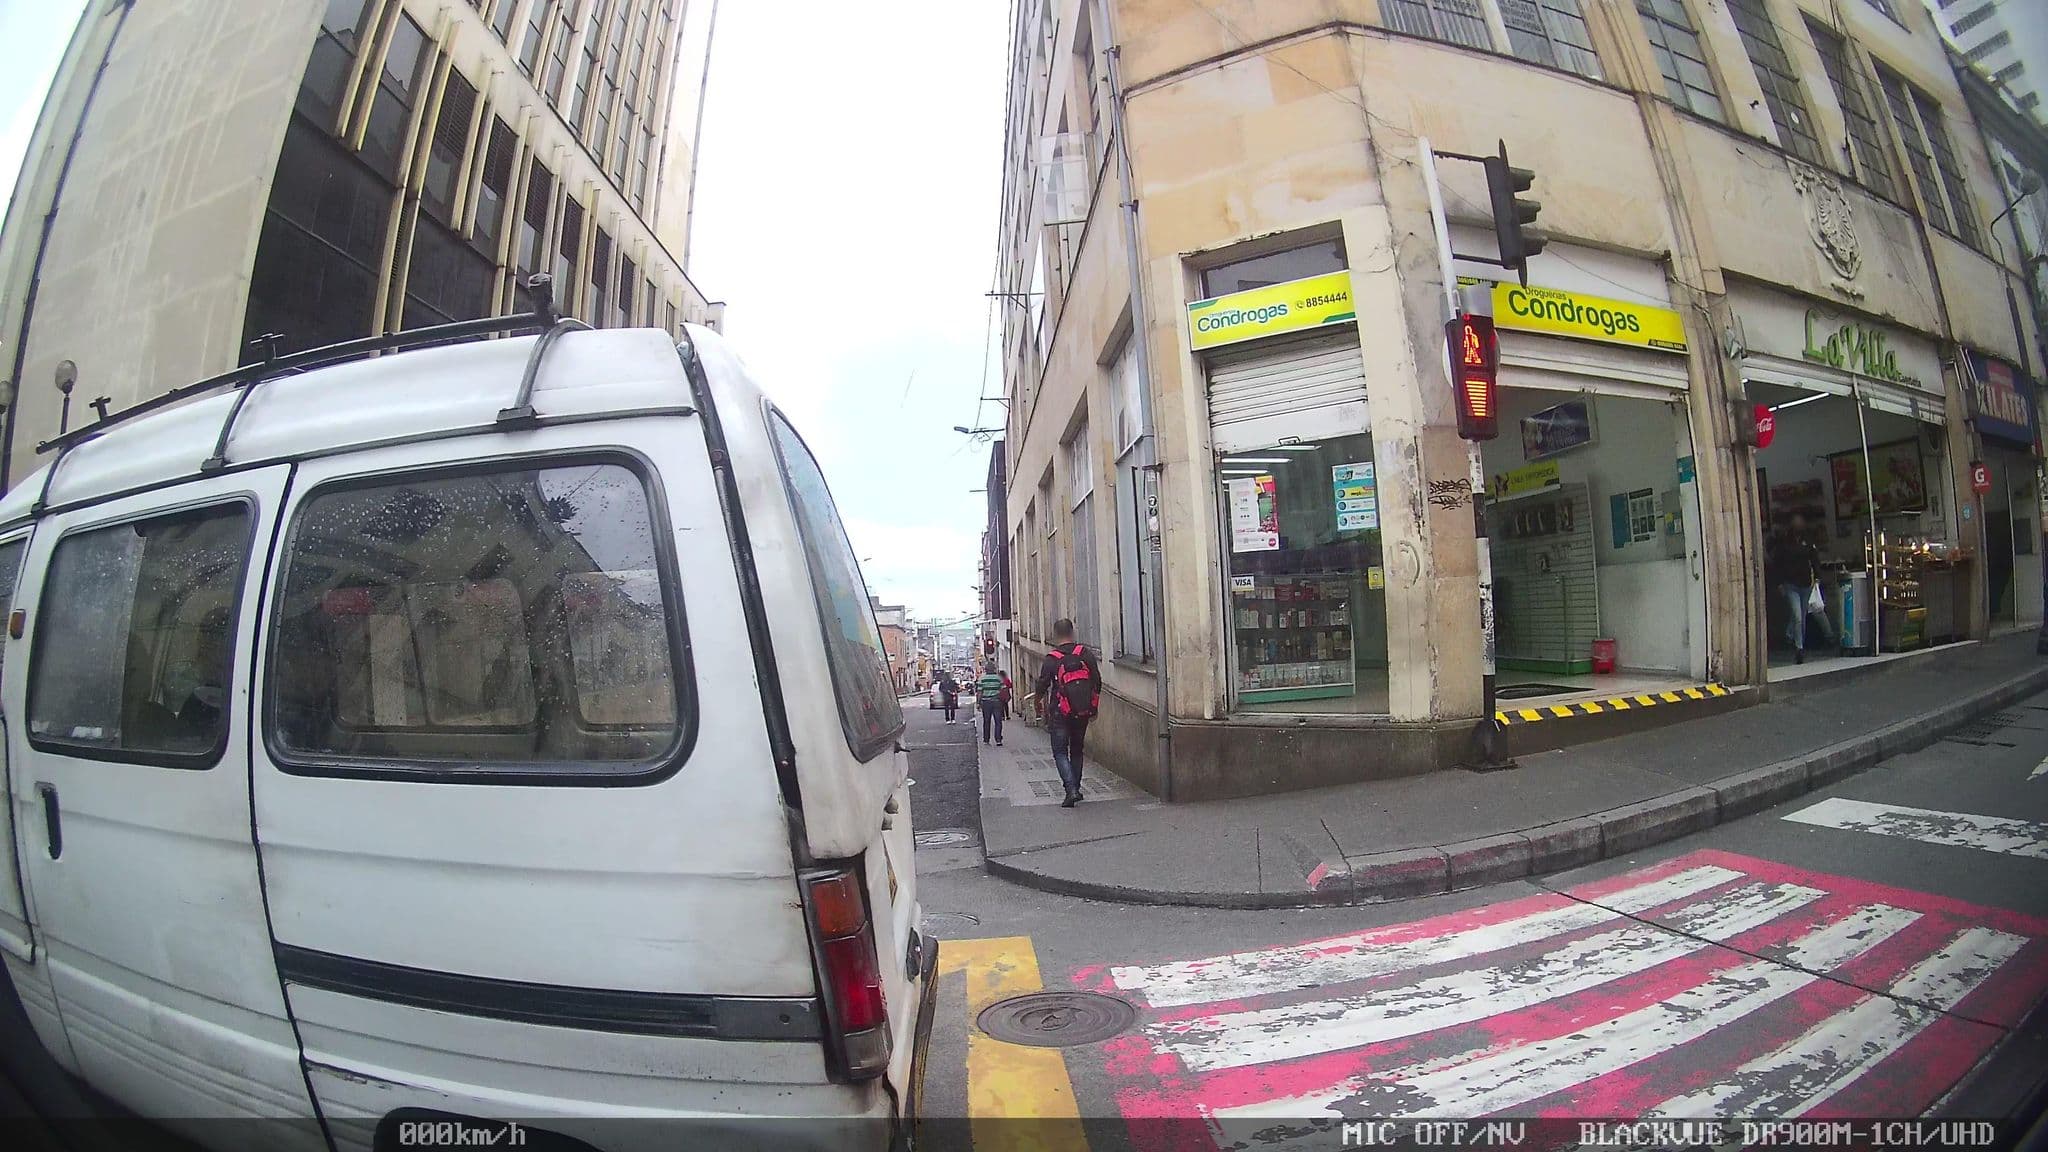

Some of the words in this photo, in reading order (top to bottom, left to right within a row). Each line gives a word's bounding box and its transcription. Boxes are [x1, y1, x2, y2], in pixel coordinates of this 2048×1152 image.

[1305, 291, 1348, 308] 8854444
[1197, 303, 1288, 332] Condrogas
[1508, 290, 1640, 336] Condrogas
[1974, 467, 1985, 483] G
[1234, 578, 1252, 587] VISA
